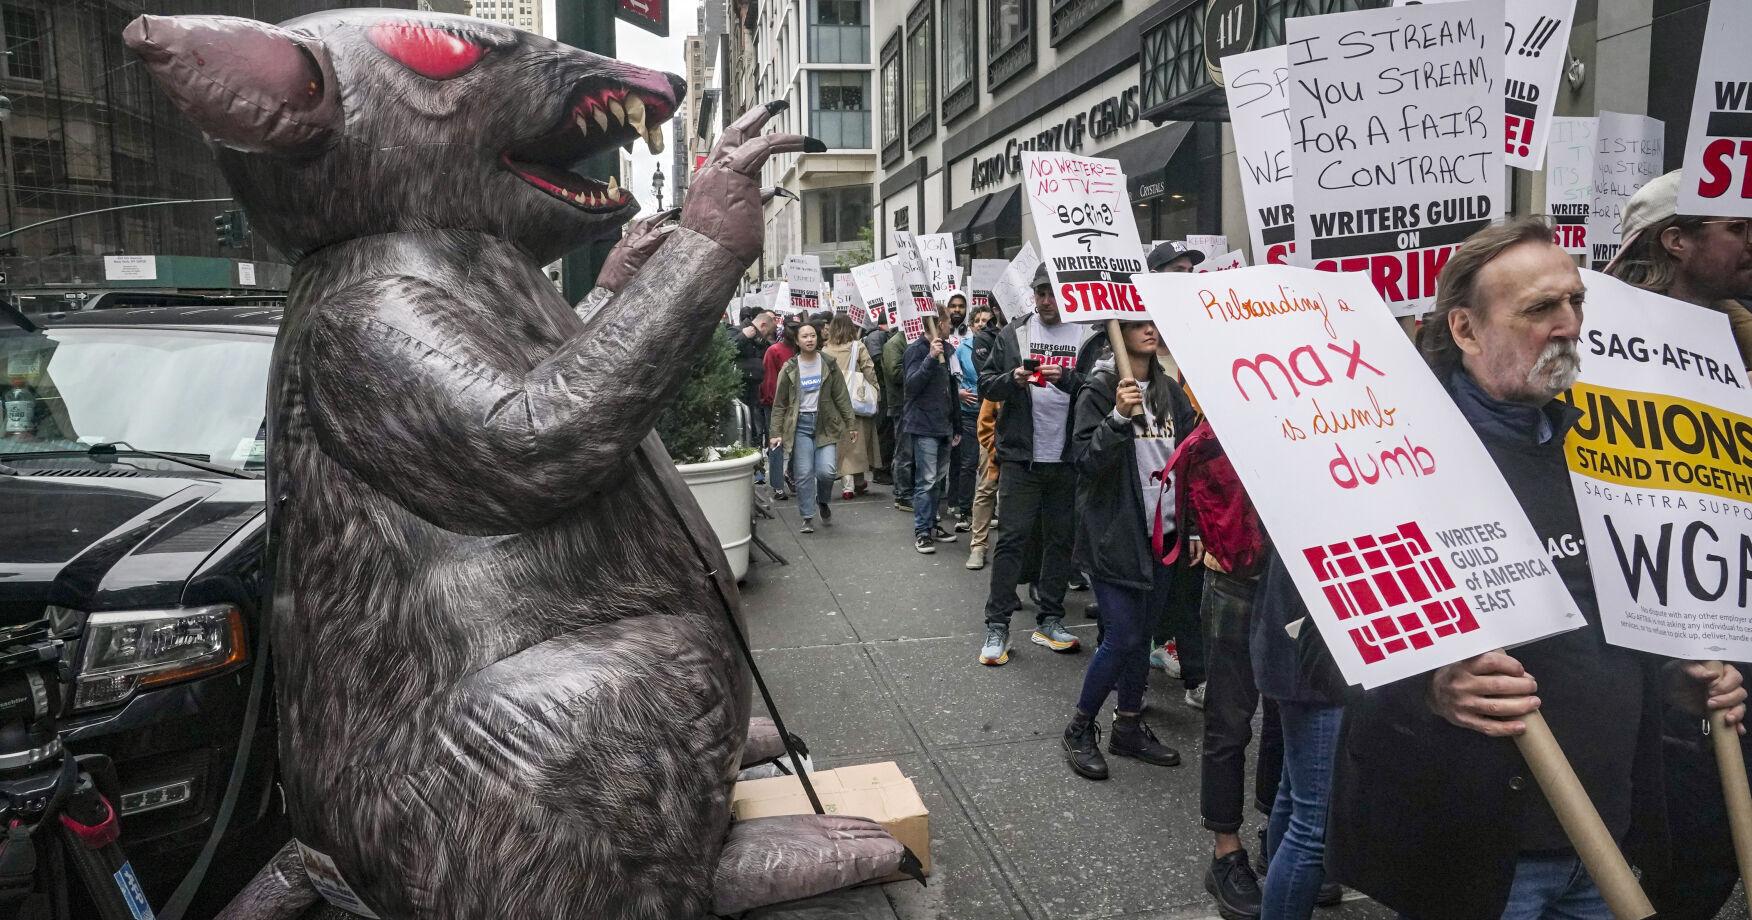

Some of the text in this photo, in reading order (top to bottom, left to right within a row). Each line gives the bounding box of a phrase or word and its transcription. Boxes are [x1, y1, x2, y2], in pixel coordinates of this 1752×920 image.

[1216, 3, 1243, 49] 417
[1289, 17, 1485, 66] I STREAM,
[1378, 56, 1493, 94] STREAM,
[1064, 112, 1087, 151] OF
[1088, 85, 1140, 139] GEMS
[1367, 115, 1390, 146] A
[1030, 157, 1053, 179] NO
[1243, 150, 1293, 185] WE
[1317, 151, 1493, 190] CONTRACT
[1038, 179, 1059, 196] NO
[1310, 195, 1492, 238] WRITERS GUILD
[1396, 231, 1420, 250] ON
[1052, 255, 1142, 272] WRITERS GUILD
[1100, 270, 1112, 282] ON
[791, 297, 820, 309] STRIKE!
[1198, 285, 1337, 339] Rebranding
[1281, 385, 1396, 441] is dumb
[1328, 435, 1436, 490] dumb
[1576, 445, 1652, 481] STAND
[1584, 481, 1688, 510] SAG-AFTRA
[1436, 521, 1508, 549] WRITERS
[1450, 546, 1499, 570] GUILD
[1465, 558, 1552, 591] of AMERICA
[1666, 618, 1687, 630] asking
[1702, 621, 1736, 631] individual
[1668, 610, 1682, 619] with
[1684, 613, 1697, 621] any
[1699, 611, 1718, 620] other
[1719, 614, 1747, 624] employer
[1674, 629, 1687, 639] pick
[1688, 633, 1700, 641] up,
[1702, 631, 1727, 641] deliver,
[1728, 634, 1749, 642] handle
